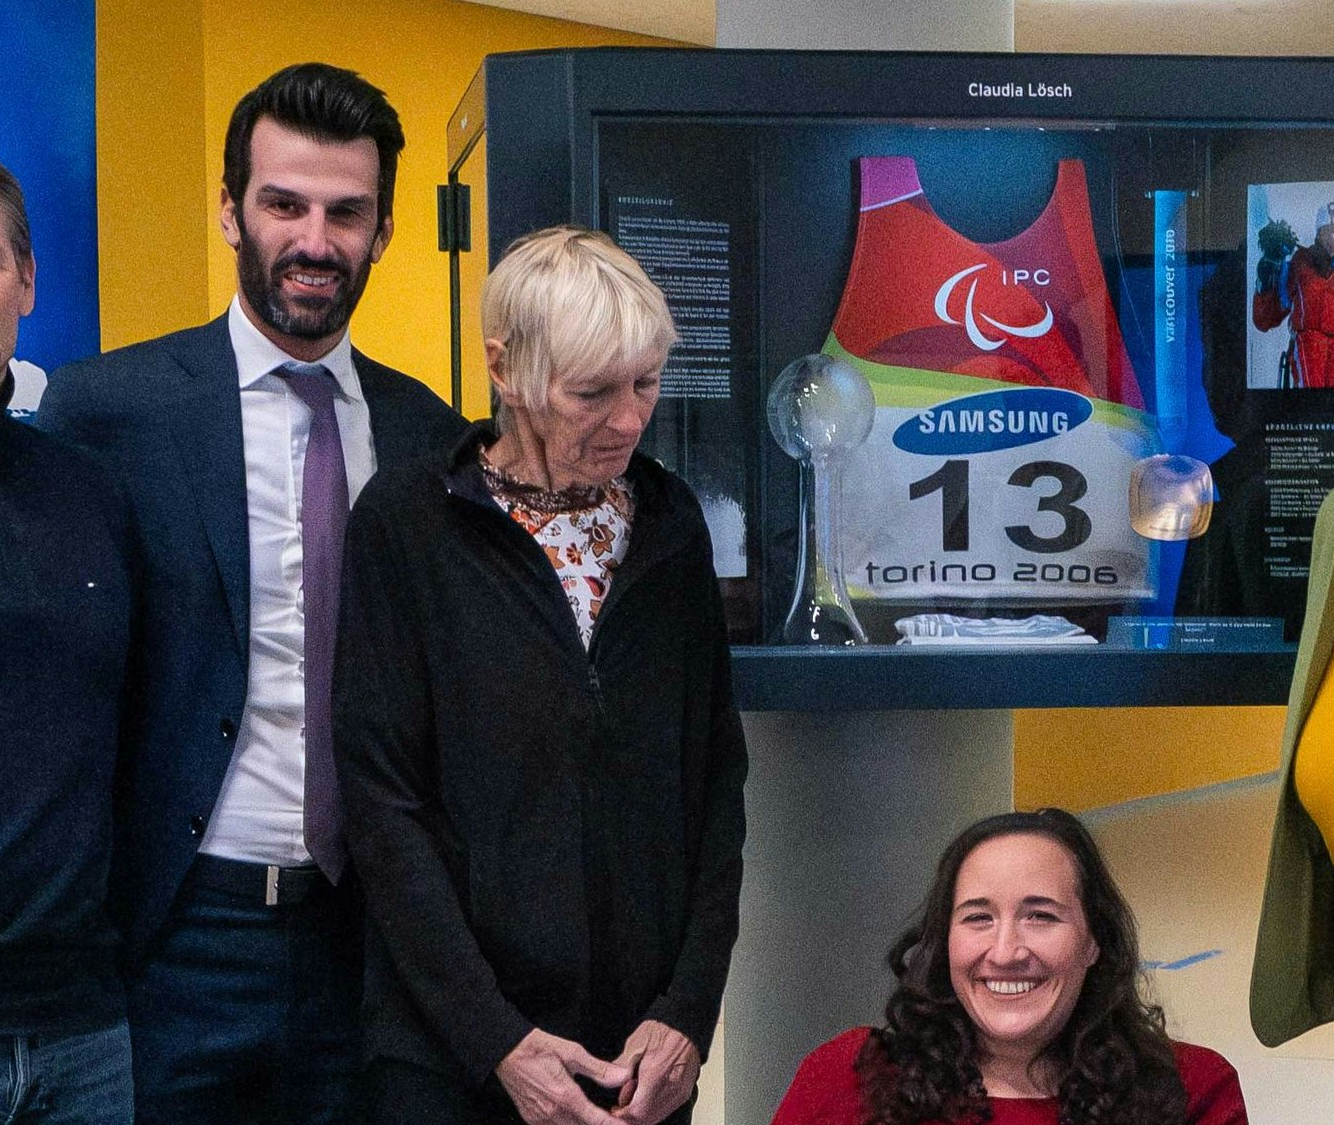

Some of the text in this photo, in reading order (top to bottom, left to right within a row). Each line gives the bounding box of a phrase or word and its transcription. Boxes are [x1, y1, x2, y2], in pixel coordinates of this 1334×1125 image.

[968, 82, 1072, 98] Claudia Lösch
[1002, 268, 1050, 286] IPC
[919, 410, 1068, 434] SAMSUNG
[909, 459, 1092, 553] 13
[866, 561, 1118, 585] torino 2006
